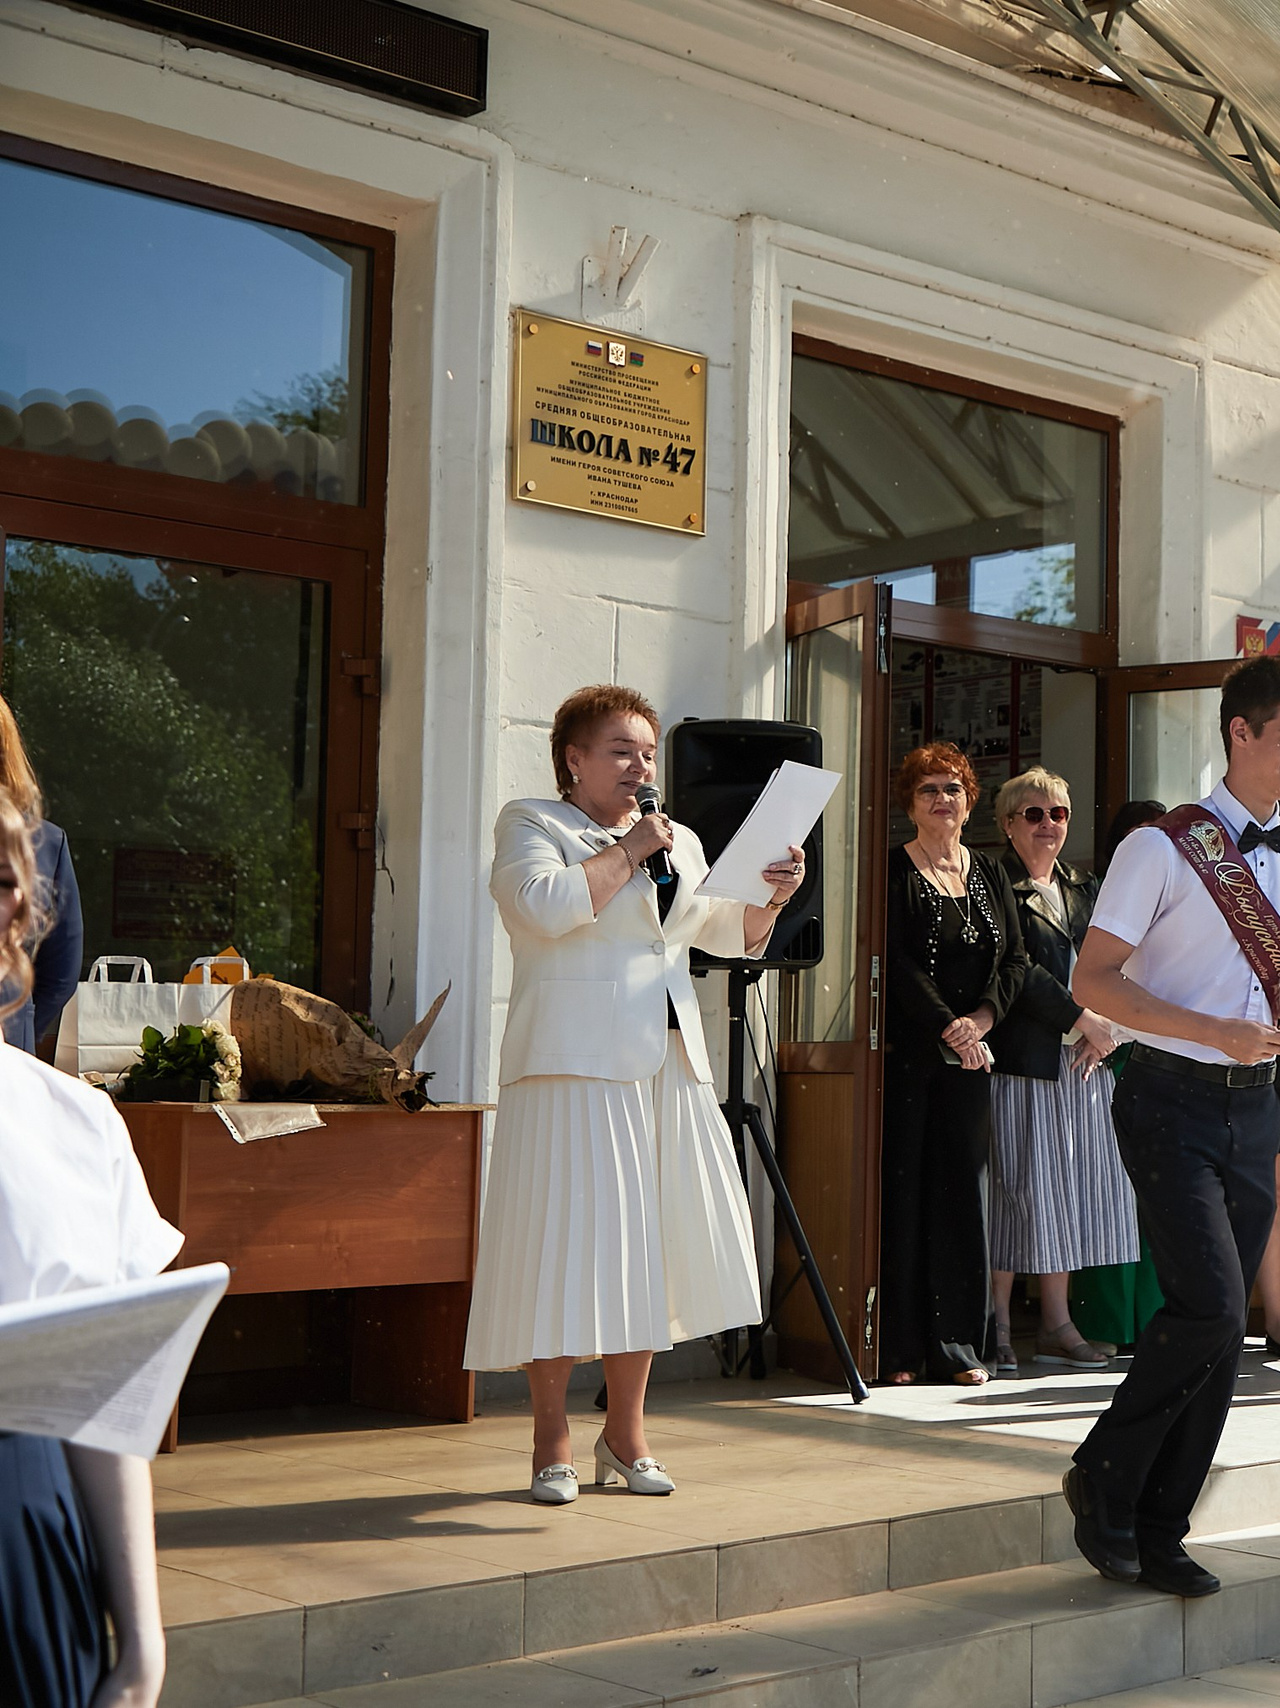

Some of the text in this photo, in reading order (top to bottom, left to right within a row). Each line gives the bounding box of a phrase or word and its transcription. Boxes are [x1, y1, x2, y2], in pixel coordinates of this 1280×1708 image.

[571, 361, 659, 386] МИНИСТЕРСТВО ПРОСВЕЩЕНИЯ
[578, 370, 652, 392] РОССИЙСКОЙ ФЕДЕРАЦИИ
[557, 384, 671, 415] ОБЩЕОБРАЗОВАТЕЛЬНОЕ УЧРЕЖДЕНИЕ
[569, 379, 660, 405] МУНИЦИПАЛЬНОЕ БЮДЖЕТНОЕ
[536, 386, 690, 426] МУНИЦИПАЛЬНОГО ОБРАЗОВАНИЯ ГОРОД КРАСНОДАР
[535, 400, 691, 443] СРЕДНЯЯ ОБЩЕОБРАЗОВАТЕЛЬНАЯ
[530, 418, 632, 463] ШКОЛА
[550, 456, 675, 488] ИМЕНИ ГЕРОЯ СОВЕТСКОГО СОЮЗА
[587, 473, 642, 491] ИВАНА ТУШЕВА
[590, 498, 603, 507] ИНН
[597, 491, 639, 505] КРАСНОДАР
